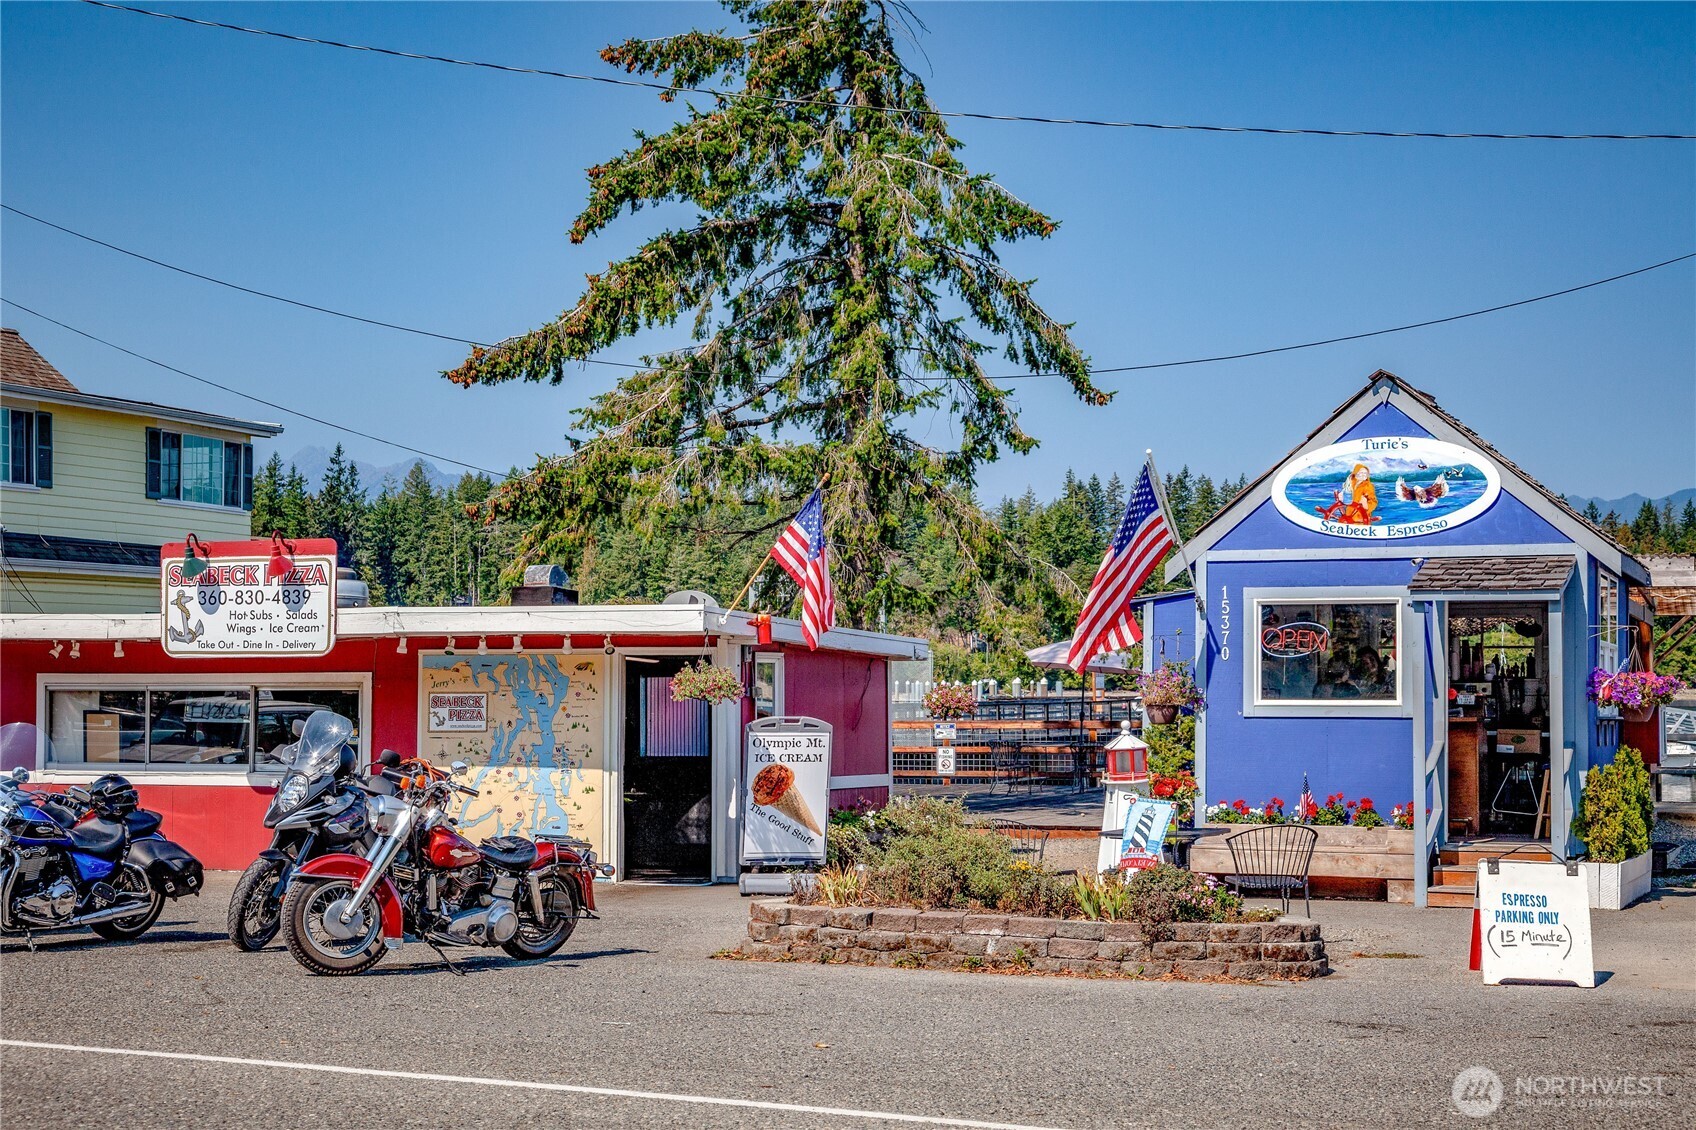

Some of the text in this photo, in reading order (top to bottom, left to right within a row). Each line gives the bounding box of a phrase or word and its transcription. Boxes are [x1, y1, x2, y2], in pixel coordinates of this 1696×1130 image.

[1361, 437, 1409, 450] Turie's
[1320, 518, 1448, 537] Seabeck Espresso
[198, 589, 311, 606] 360-830-4839
[229, 609, 318, 620] Hot Subs Salads
[226, 623, 320, 635] Wings Ice Cream
[1220, 585, 1230, 661] 15370
[197, 640, 316, 651] Take Out Dine In Delivery
[1261, 627, 1327, 652] OPEN
[431, 677, 456, 689] Jerry's
[431, 695, 484, 709] SEABECK
[448, 708, 485, 722] PIZZA
[752, 737, 826, 750] Olympic Mt.
[754, 753, 823, 763] ICE CREAM
[750, 803, 815, 846] The Good Stuff
[1502, 892, 1548, 908] ESPRESSO
[1495, 910, 1560, 925] PARKING ONLY
